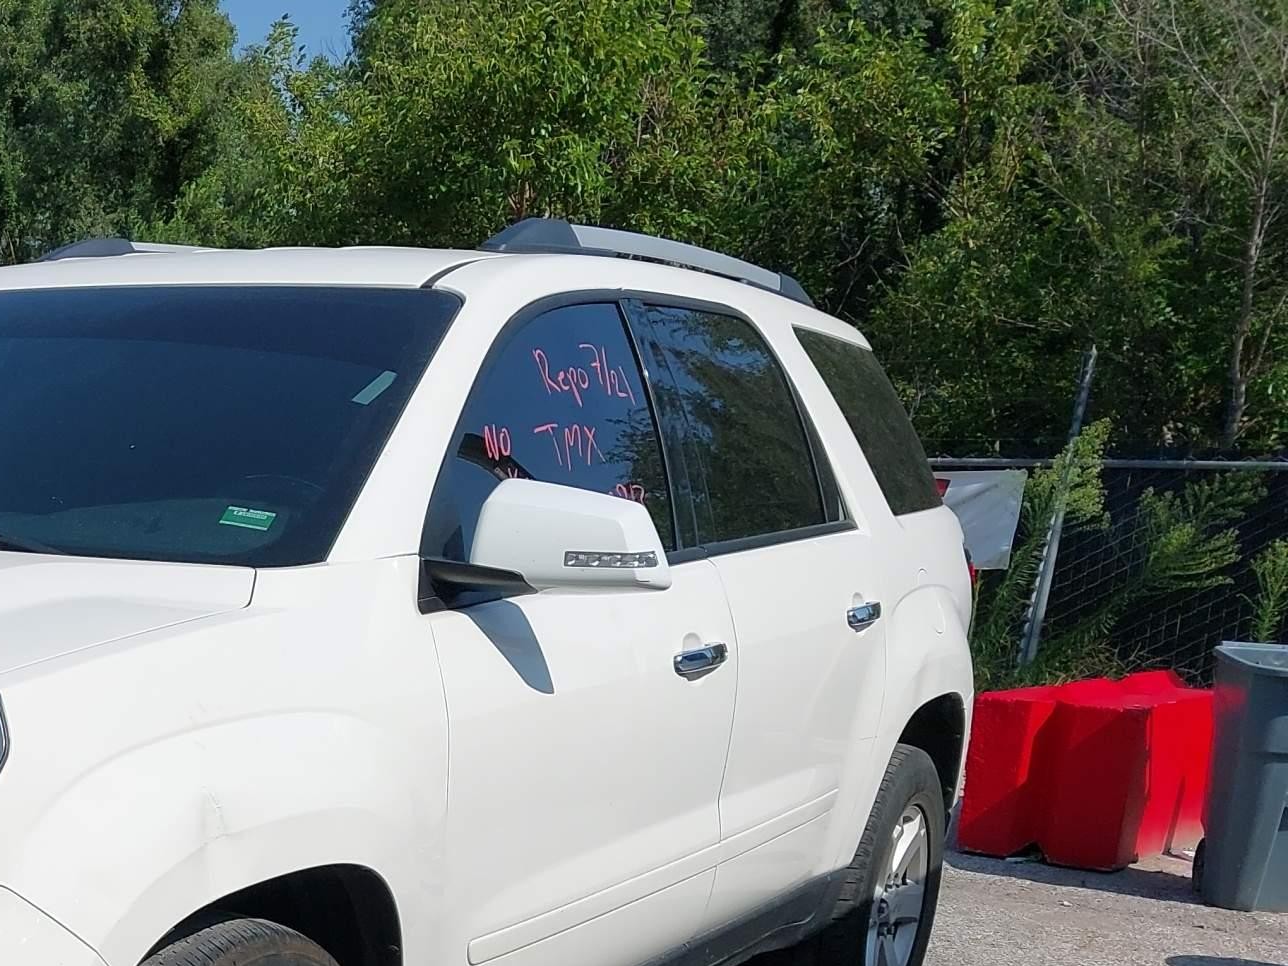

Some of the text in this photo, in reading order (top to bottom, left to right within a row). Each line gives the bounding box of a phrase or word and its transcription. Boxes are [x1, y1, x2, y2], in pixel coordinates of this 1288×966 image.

[532, 343, 637, 408] Repo 7/21
[483, 423, 606, 472] NO TMX
